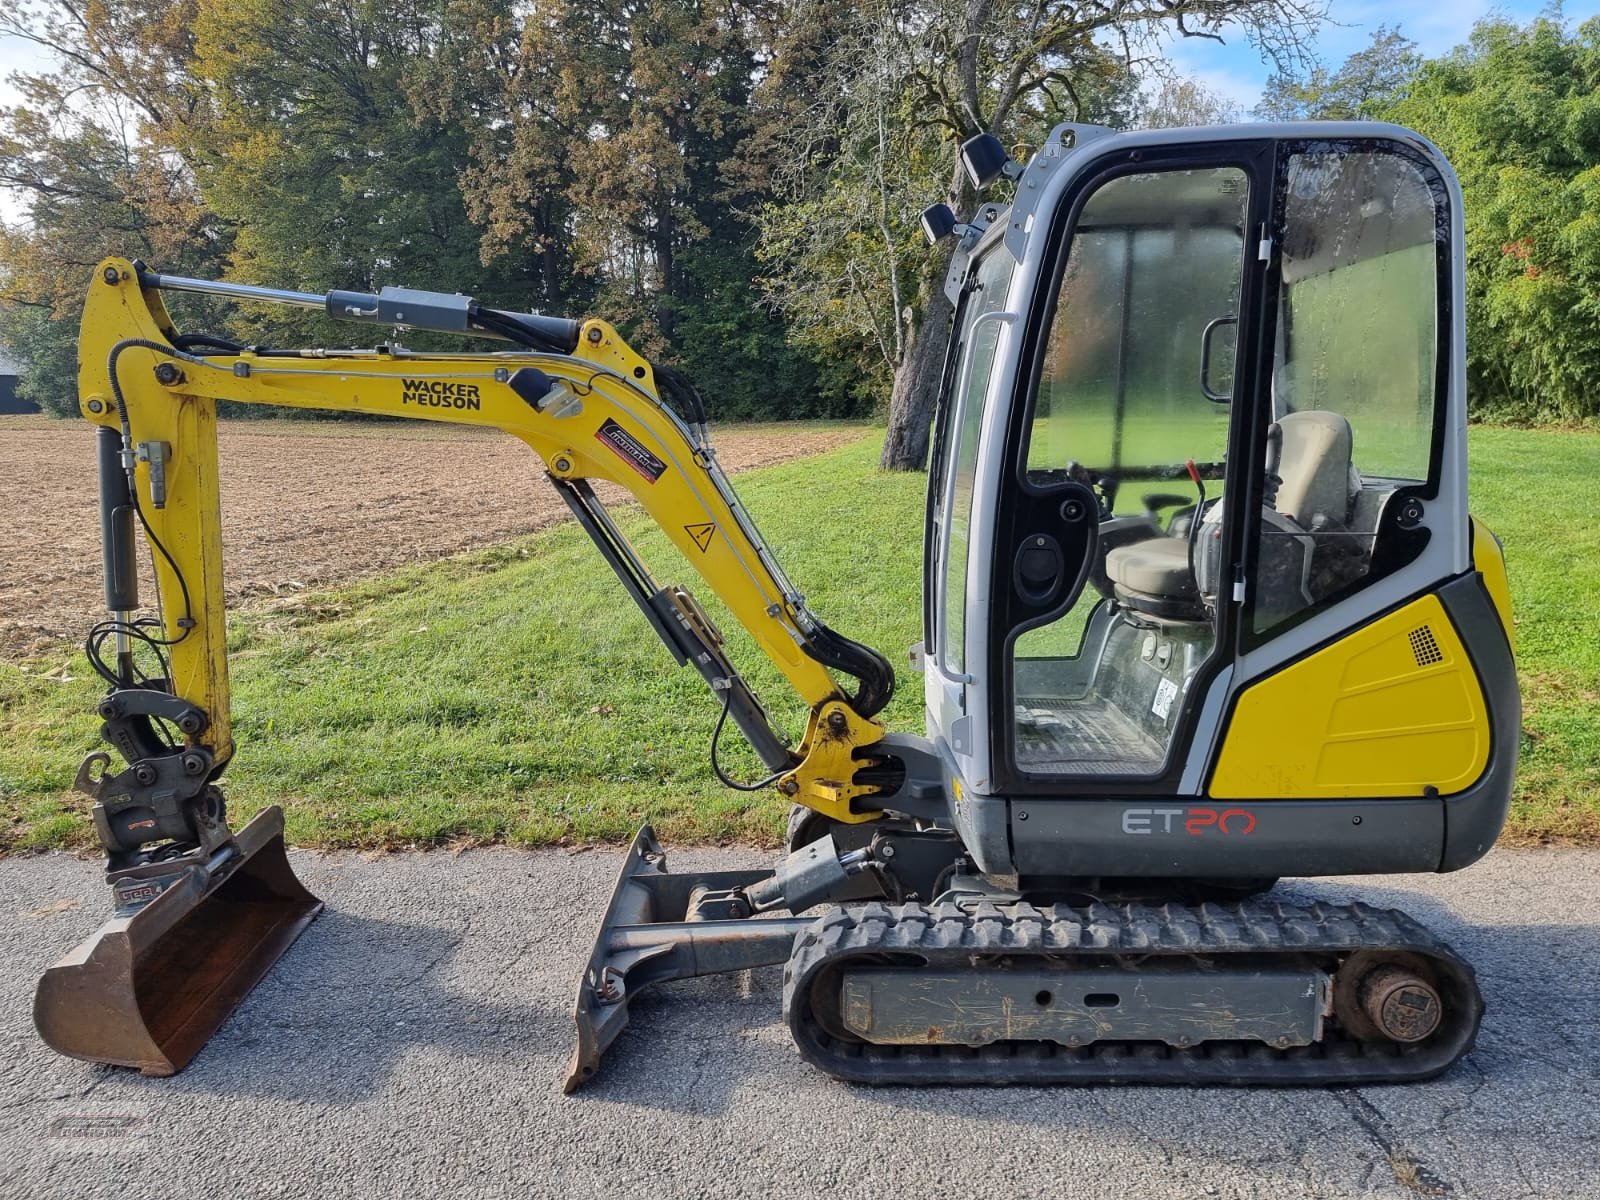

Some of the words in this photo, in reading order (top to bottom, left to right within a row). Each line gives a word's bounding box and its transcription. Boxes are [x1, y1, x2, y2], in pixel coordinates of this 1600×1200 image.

[402, 378, 480, 398] WACKER
[402, 391, 480, 411] NEUSON
[1122, 808, 1257, 835] ET20
